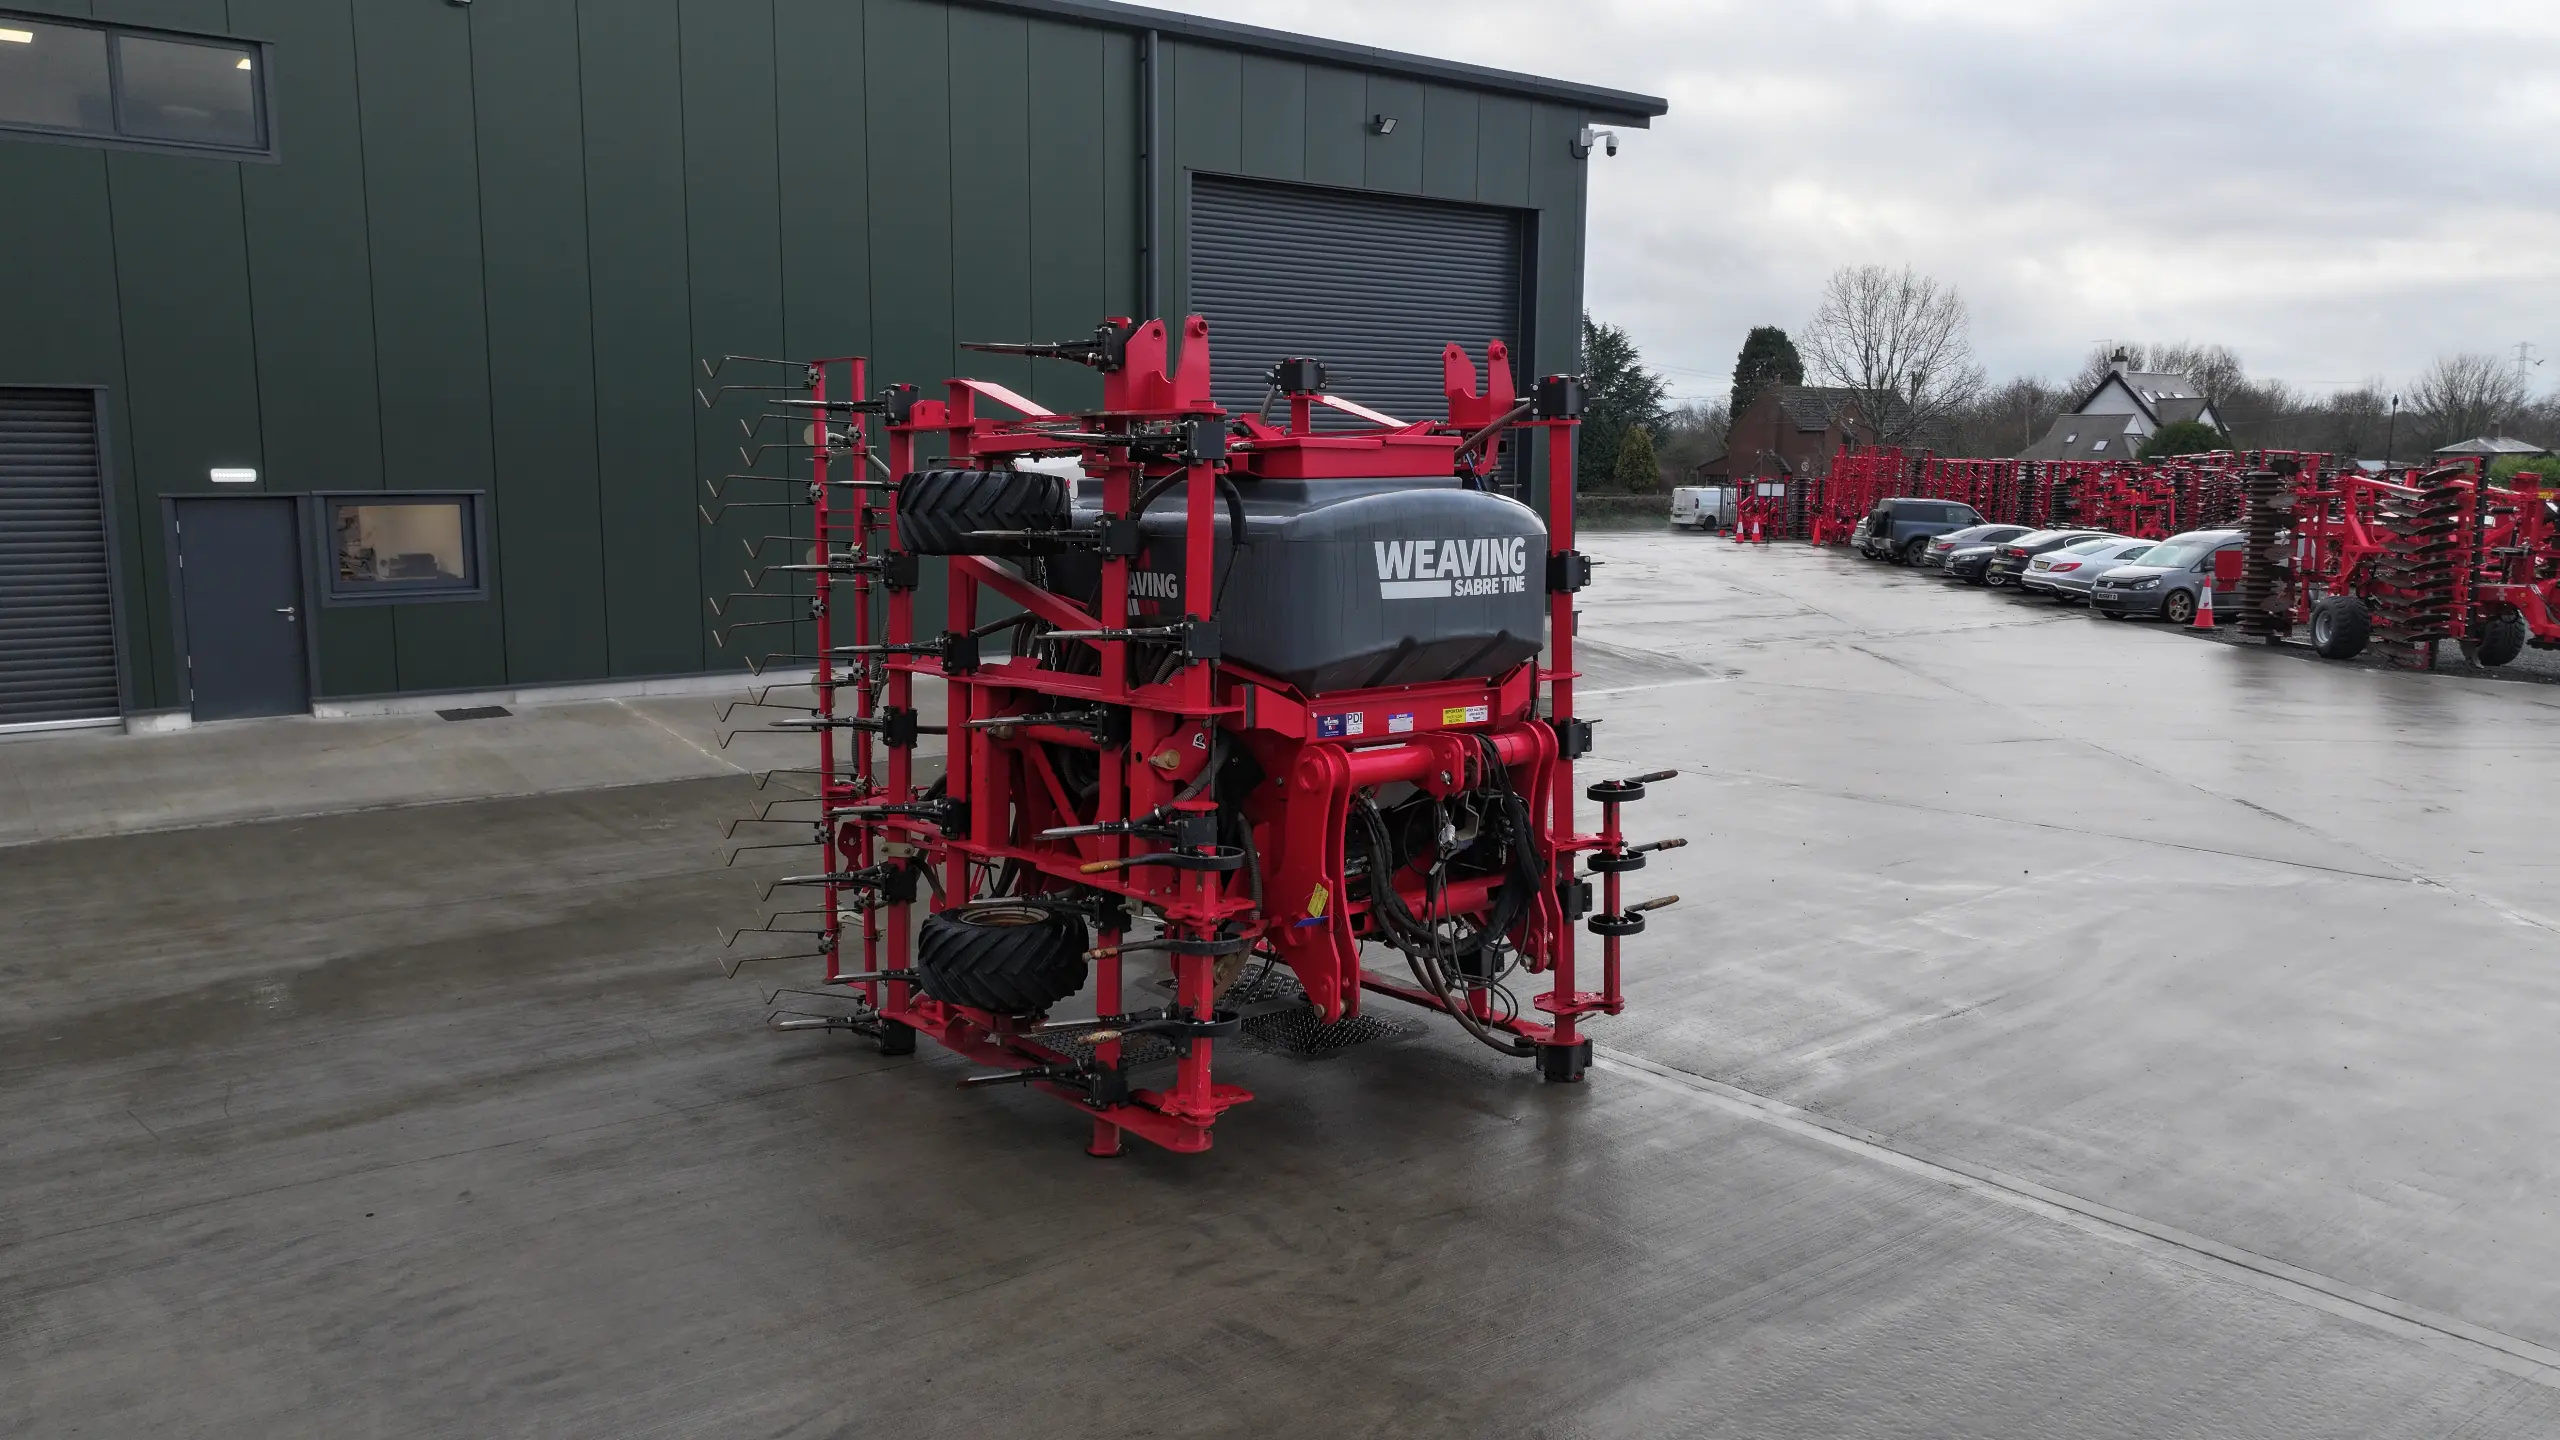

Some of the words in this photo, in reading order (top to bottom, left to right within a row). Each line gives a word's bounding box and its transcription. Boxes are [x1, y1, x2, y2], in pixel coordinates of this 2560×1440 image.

[1374, 536, 1526, 580] WEAVING
[1127, 571, 1179, 599] AVING
[1454, 577, 1500, 597] SABRE
[1501, 575, 1526, 593] TINE
[1347, 712, 1363, 724] PDI
